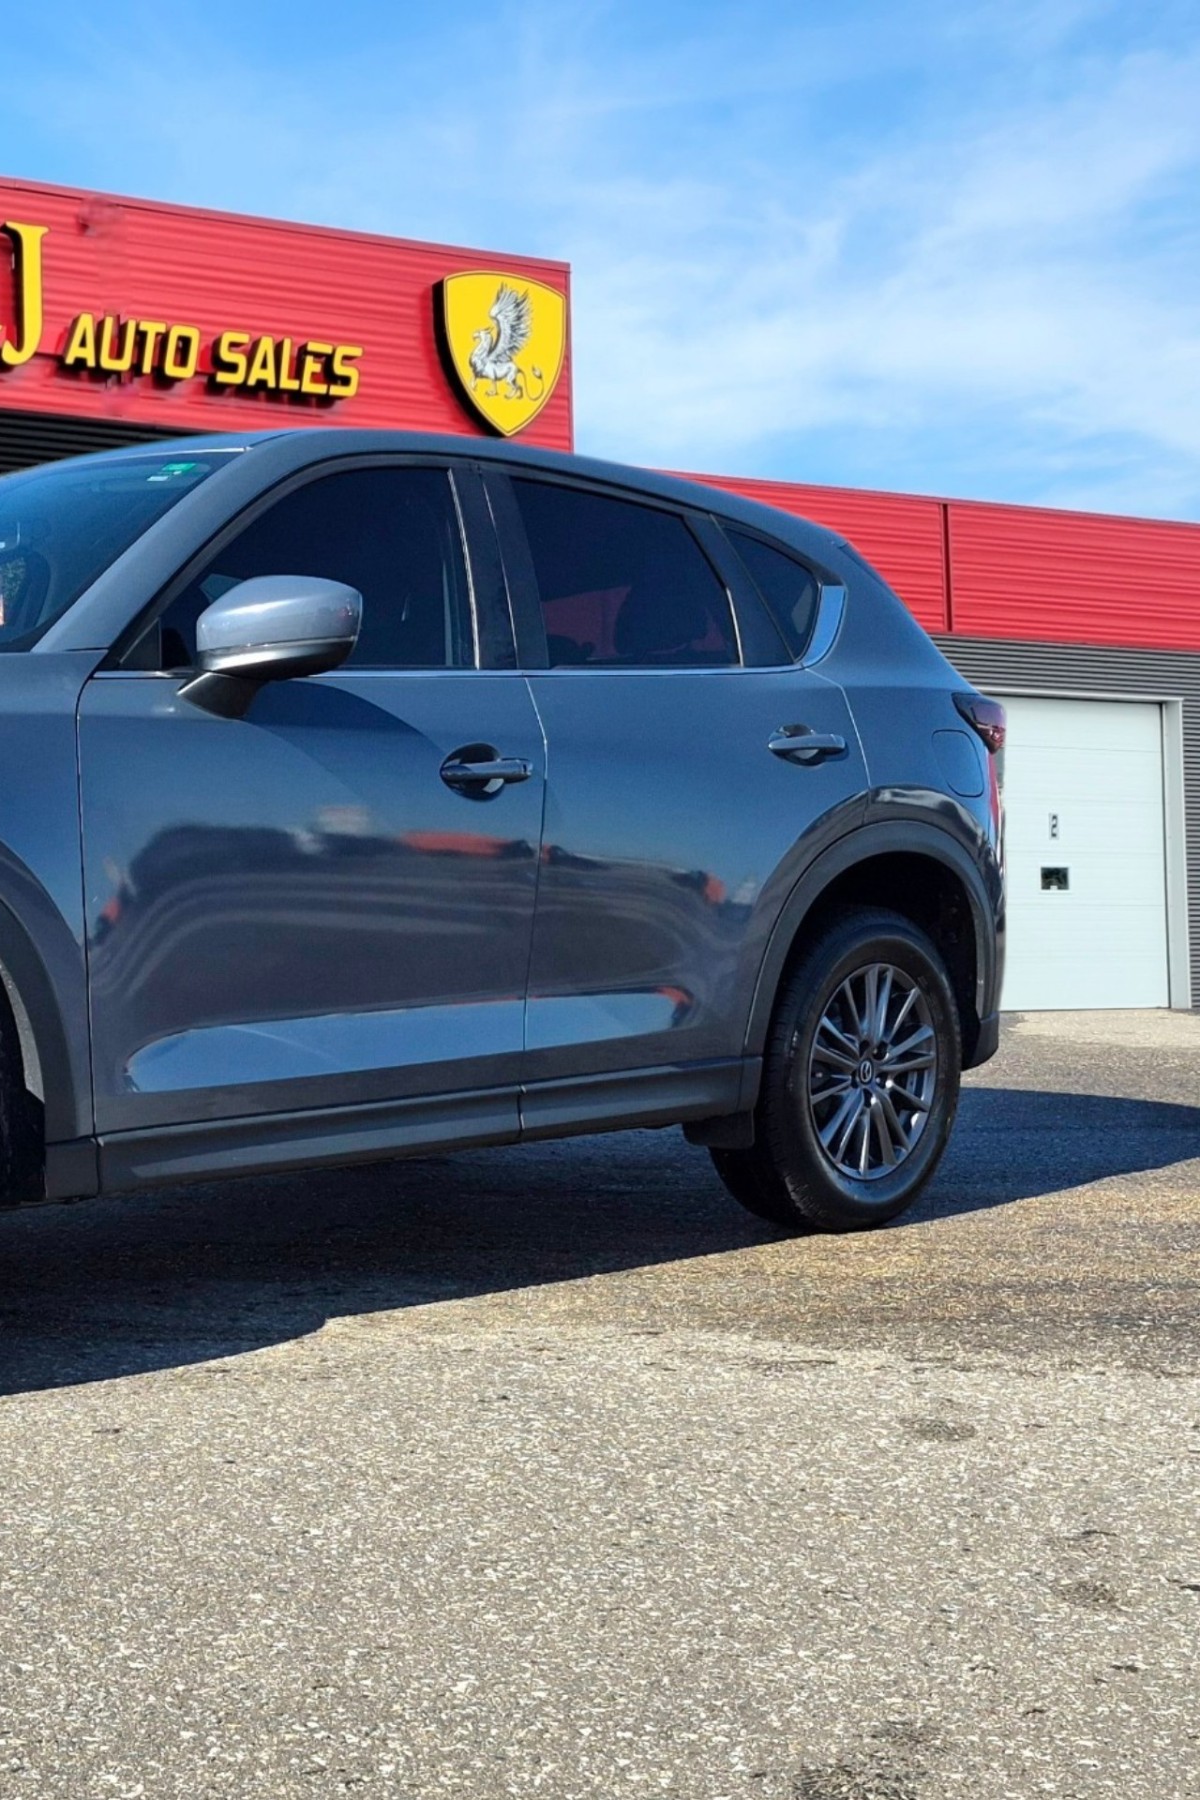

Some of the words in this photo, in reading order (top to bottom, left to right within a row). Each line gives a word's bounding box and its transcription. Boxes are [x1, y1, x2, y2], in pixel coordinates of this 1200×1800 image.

[63, 312, 201, 380] AUTO
[215, 331, 364, 398] SALES
[1050, 814, 1058, 838] 2
